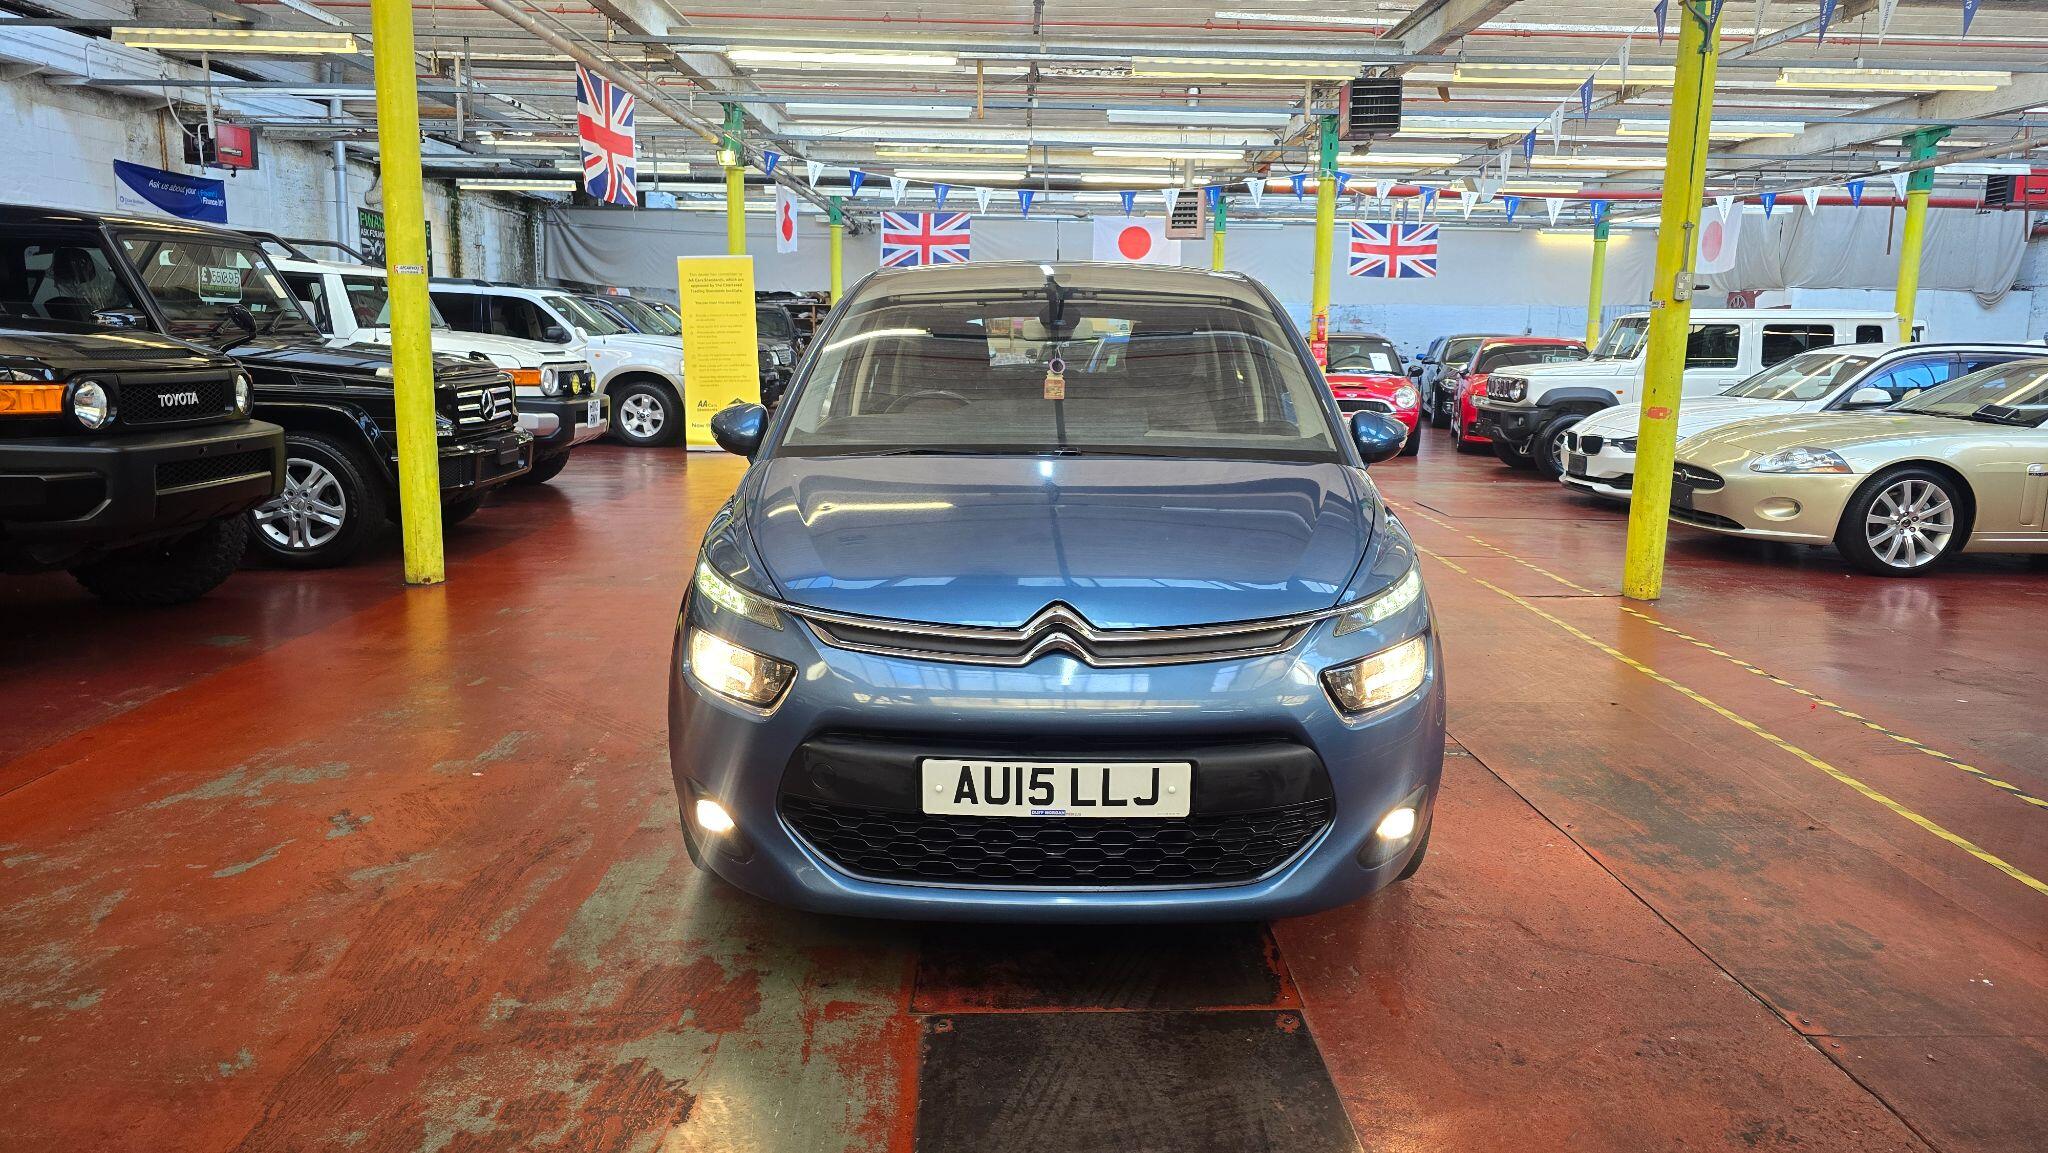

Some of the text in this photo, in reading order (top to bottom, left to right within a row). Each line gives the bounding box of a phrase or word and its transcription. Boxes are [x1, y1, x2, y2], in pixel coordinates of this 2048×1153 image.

[149, 179, 161, 189] Ask
[185, 187, 197, 196] your
[157, 391, 200, 407] TOYOTA
[953, 765, 1160, 807] AU15 LLJ
